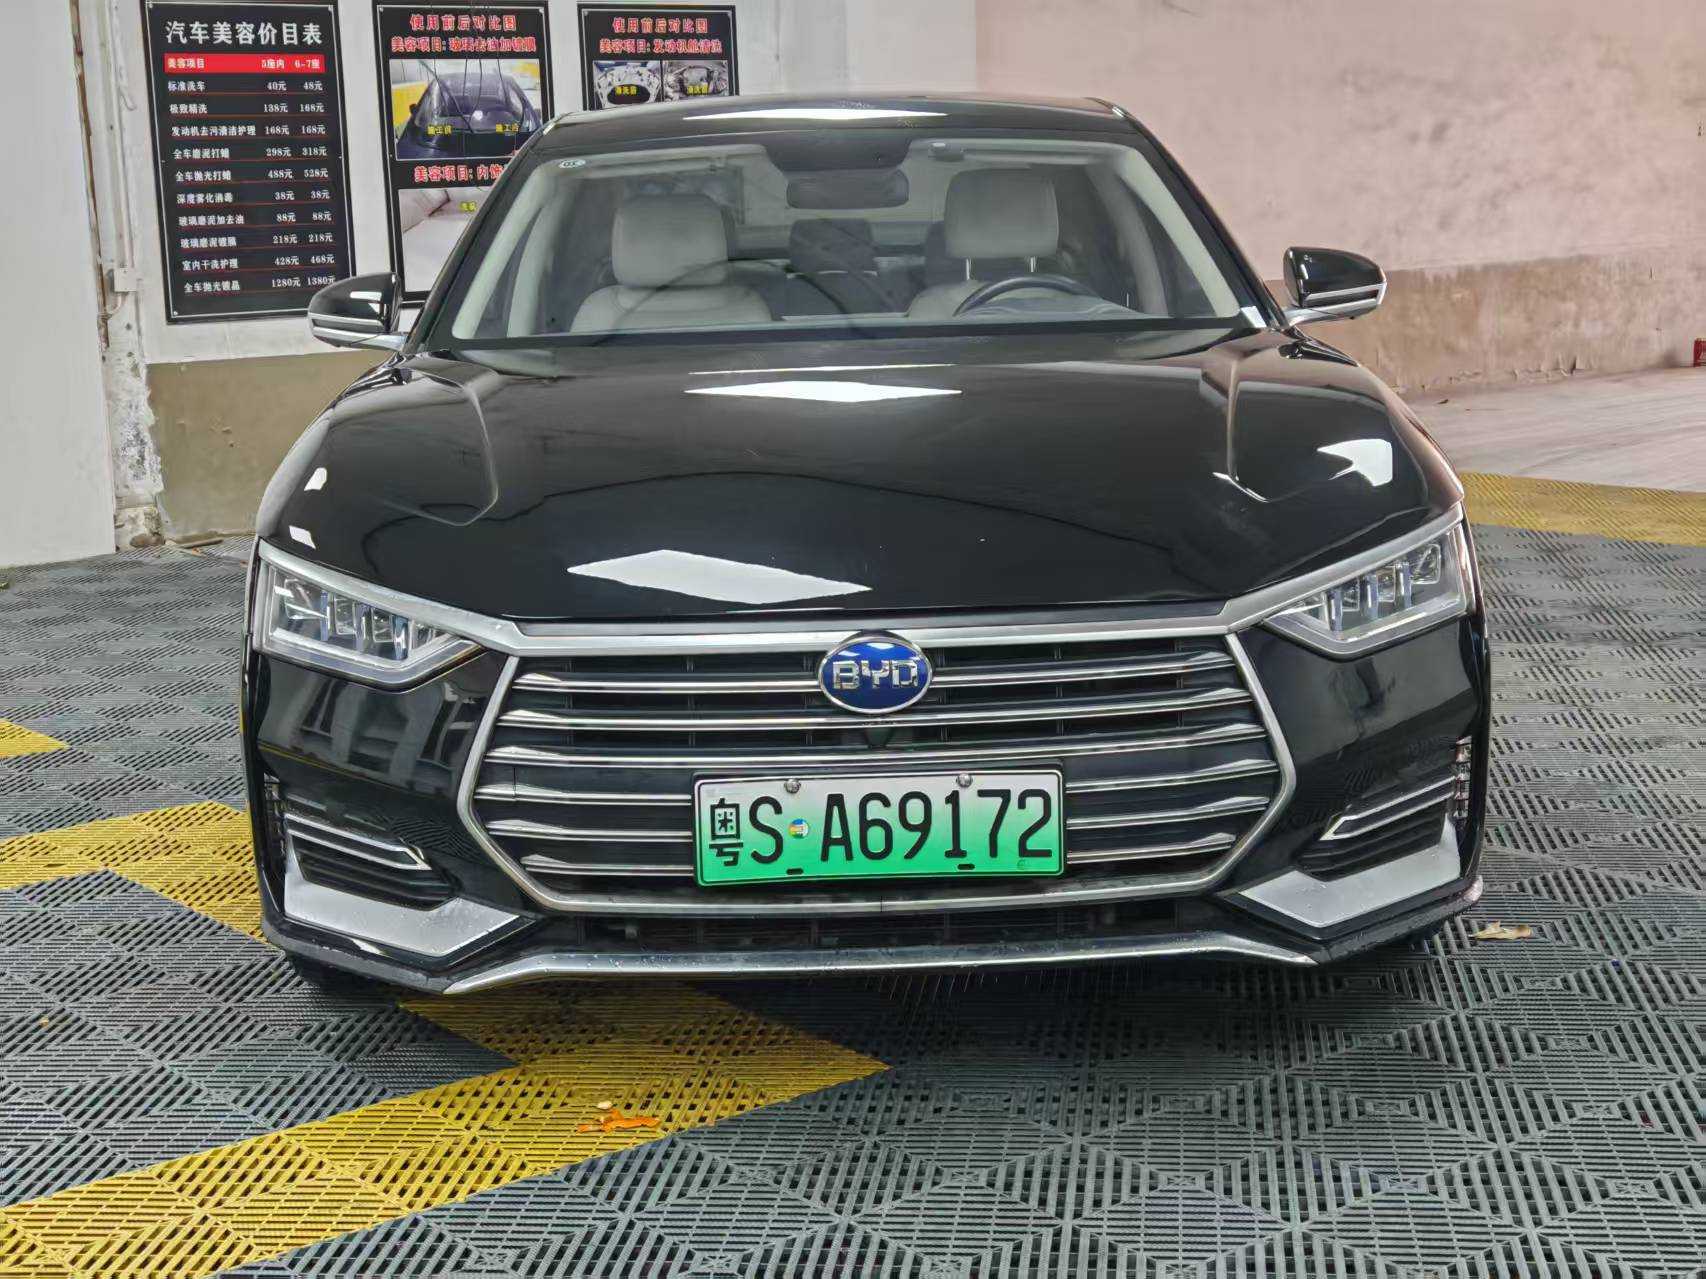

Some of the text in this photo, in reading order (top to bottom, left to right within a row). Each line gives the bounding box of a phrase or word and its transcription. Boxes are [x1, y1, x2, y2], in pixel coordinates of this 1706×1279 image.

[410, 14, 517, 31] 使用前后对比图
[612, 17, 708, 33] 使用前后对比图
[165, 21, 323, 45] 汽车美容价目表
[167, 58, 205, 69] 美容项目
[168, 80, 323, 92] 标准洗车 40元 48元
[169, 103, 324, 114] 极致精洗 138元 168元
[265, 125, 290, 135] 168元
[301, 124, 326, 135] 168元
[266, 147, 292, 158] 298元
[302, 146, 328, 157] 318元
[267, 169, 293, 179] 488元
[304, 168, 329, 178] 528元
[177, 190, 331, 204] 深度雾化消毒 38元 38元
[276, 212, 297, 223] 88元
[312, 210, 332, 221] 88元
[272, 234, 298, 245] 218元
[308, 232, 334, 243] 218元
[182, 253, 335, 271] 室内干洗护理 428元 468元
[272, 277, 301, 288] 1280元
[307, 275, 336, 286] 1380元
[832, 660, 919, 690] BYD
[820, 788, 1053, 862] A69172
